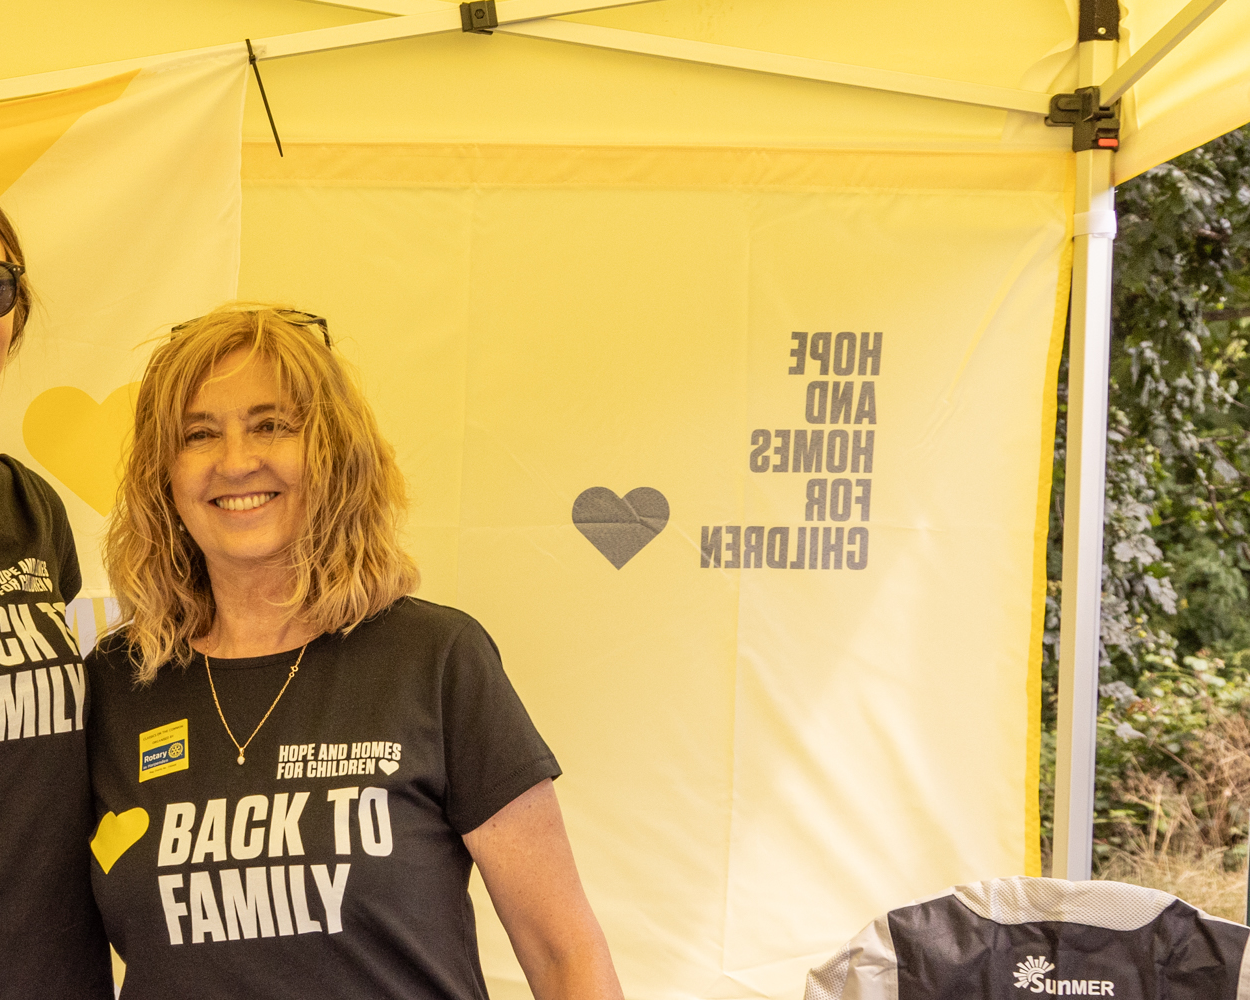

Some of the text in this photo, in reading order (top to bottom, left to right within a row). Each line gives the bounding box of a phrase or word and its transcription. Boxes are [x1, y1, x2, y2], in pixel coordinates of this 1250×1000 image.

[144, 751, 167, 763] Rotary
[279, 742, 401, 762] HOPE AND HOMES
[277, 759, 375, 779] FOR CHILDREN
[158, 787, 393, 867] BACK TO
[158, 864, 351, 945] FAMILY
